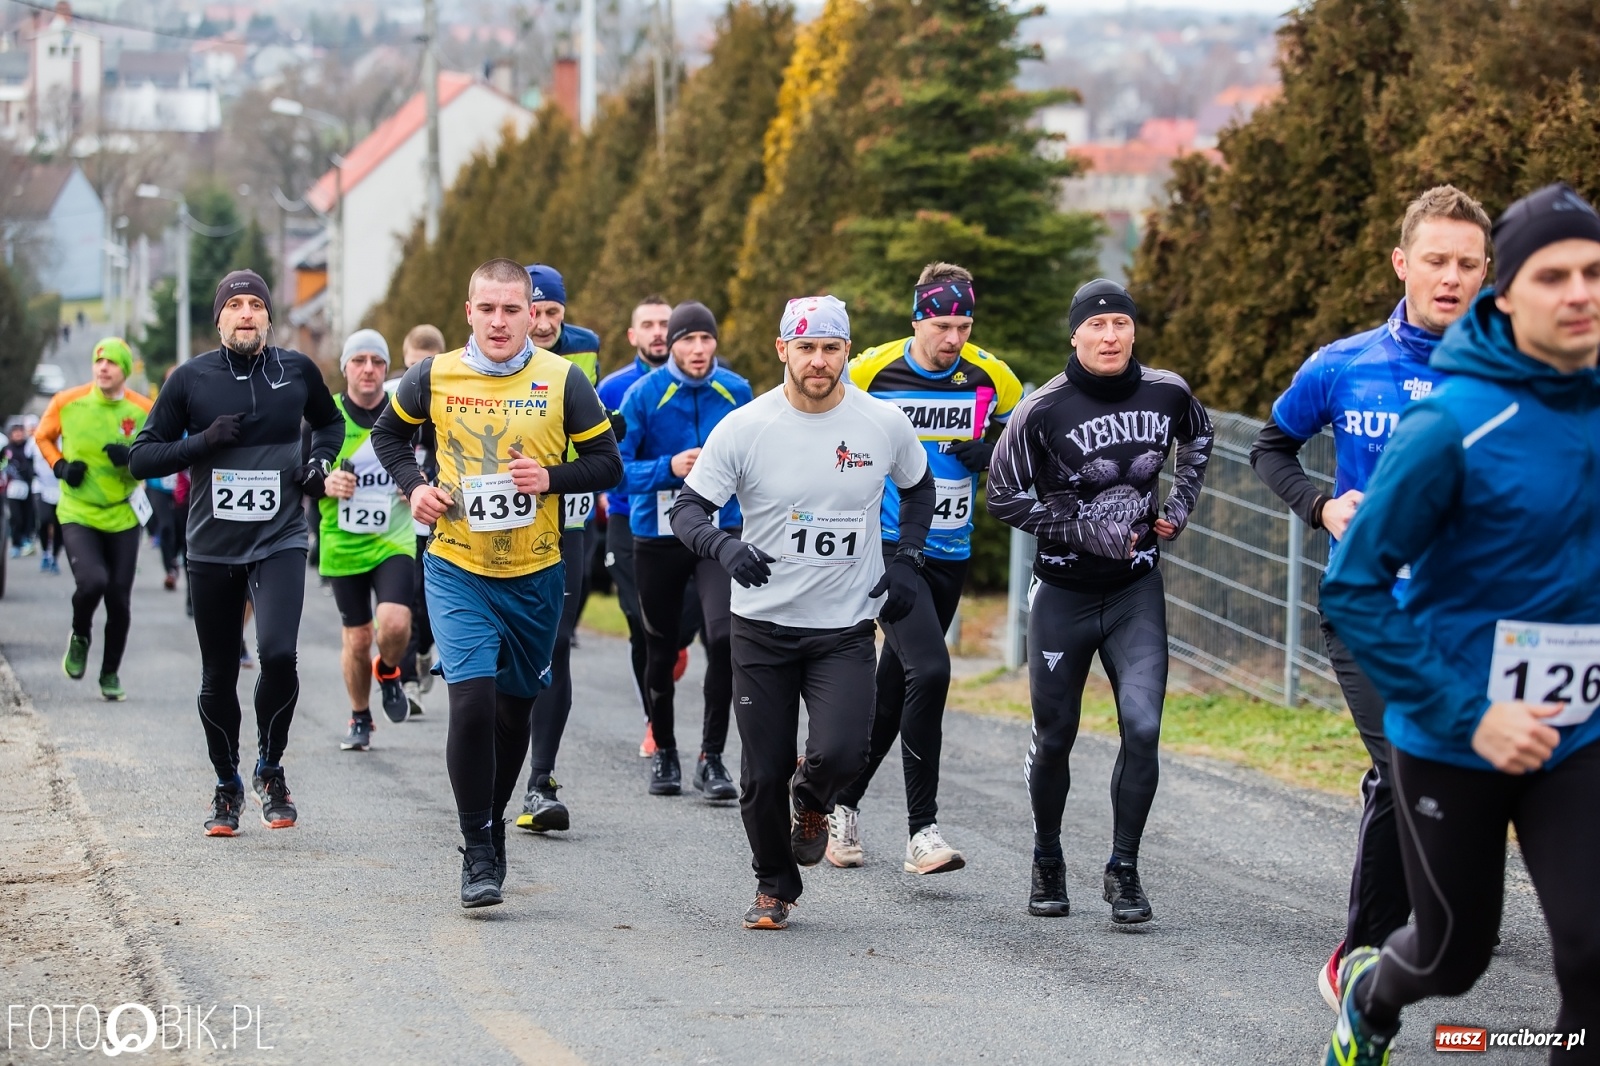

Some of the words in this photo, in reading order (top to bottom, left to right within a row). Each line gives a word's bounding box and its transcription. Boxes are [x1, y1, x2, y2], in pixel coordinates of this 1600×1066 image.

[446, 396, 502, 407] ENERGY
[507, 399, 547, 409] TEAM
[446, 406, 547, 417] BOLATICE
[898, 406, 972, 430] RAMBA
[1065, 410, 1171, 456] VENUM
[847, 460, 873, 468] STORM
[216, 488, 276, 511] 243
[469, 493, 532, 520] 439
[934, 496, 969, 520] 45
[342, 507, 386, 526] 129
[791, 528, 857, 557] 161
[1503, 660, 1600, 704] 126
